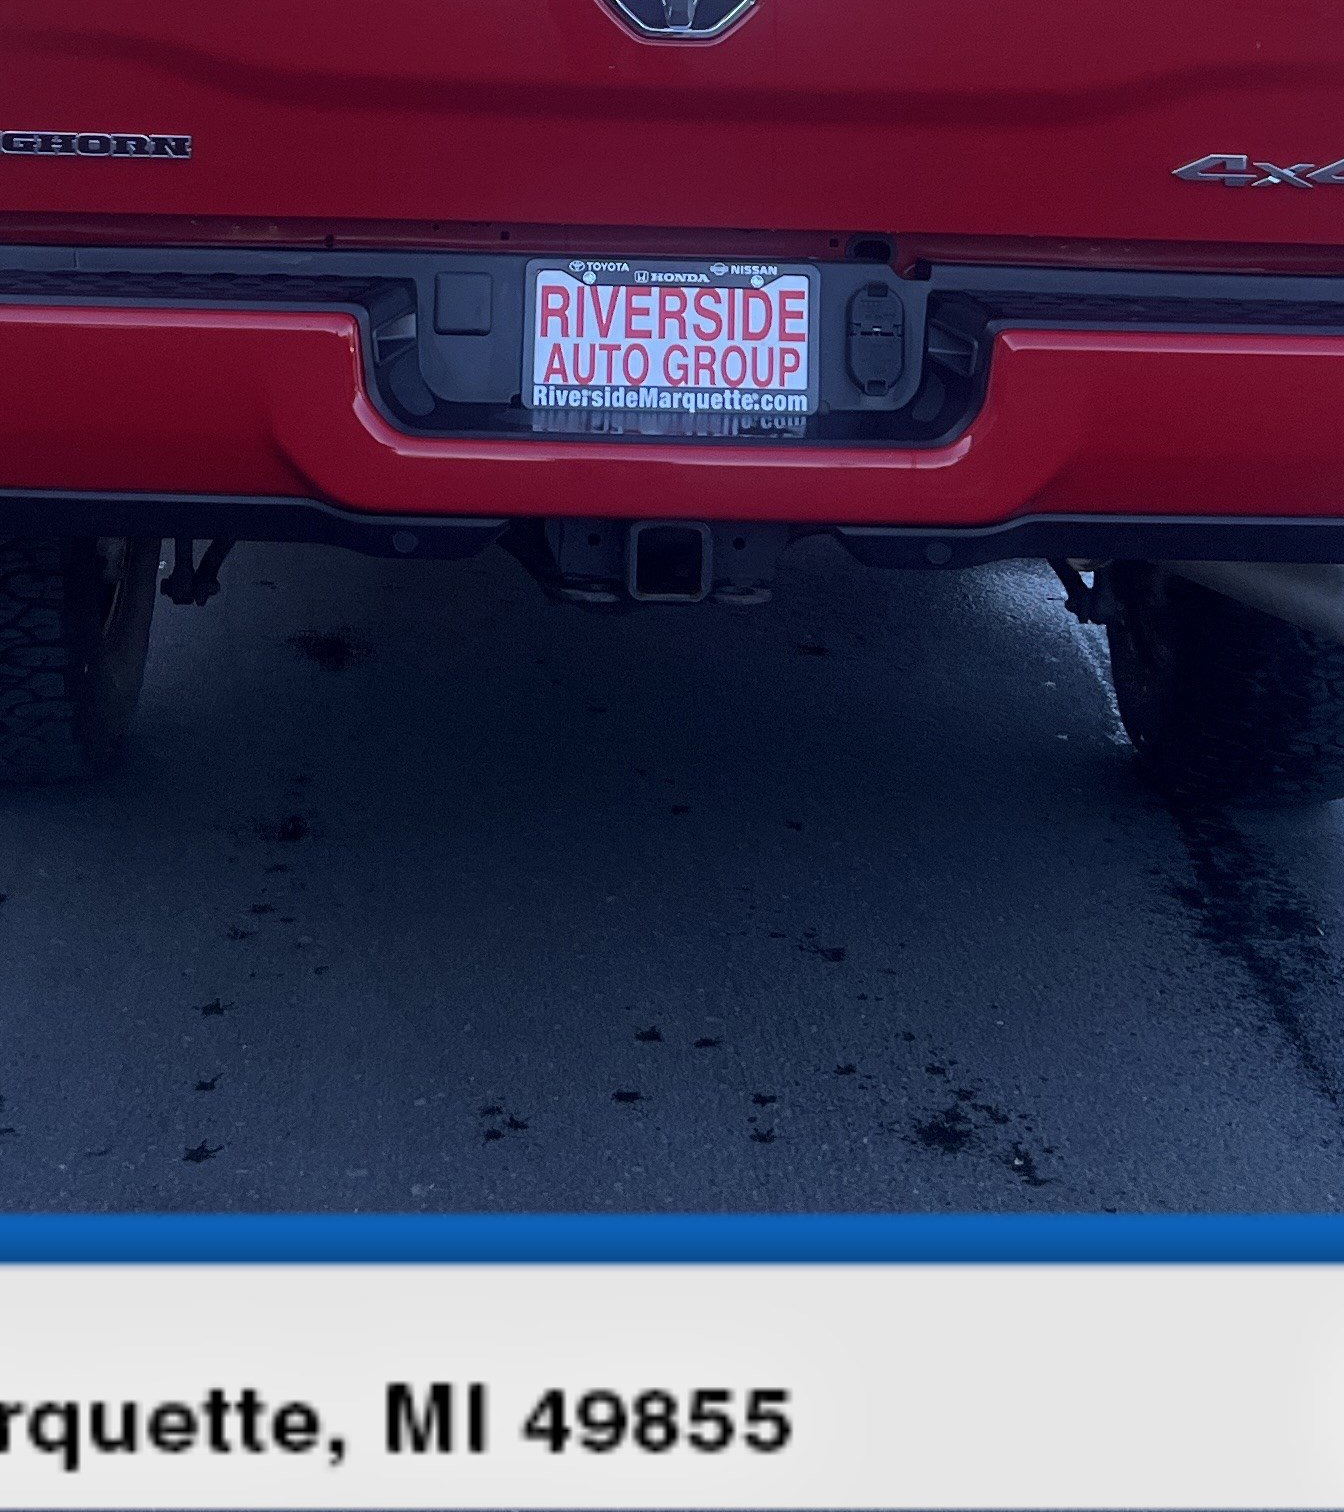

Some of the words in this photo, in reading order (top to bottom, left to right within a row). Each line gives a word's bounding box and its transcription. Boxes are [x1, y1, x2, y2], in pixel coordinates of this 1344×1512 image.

[586, 261, 630, 272] TOYOTA
[730, 264, 778, 276] NISSAN
[650, 272, 710, 283] HONDA
[540, 285, 806, 343] RIVERSIDE
[543, 343, 649, 386] AUTO
[662, 344, 800, 388] GROUP
[533, 385, 807, 412] RiversideMarquette.com
